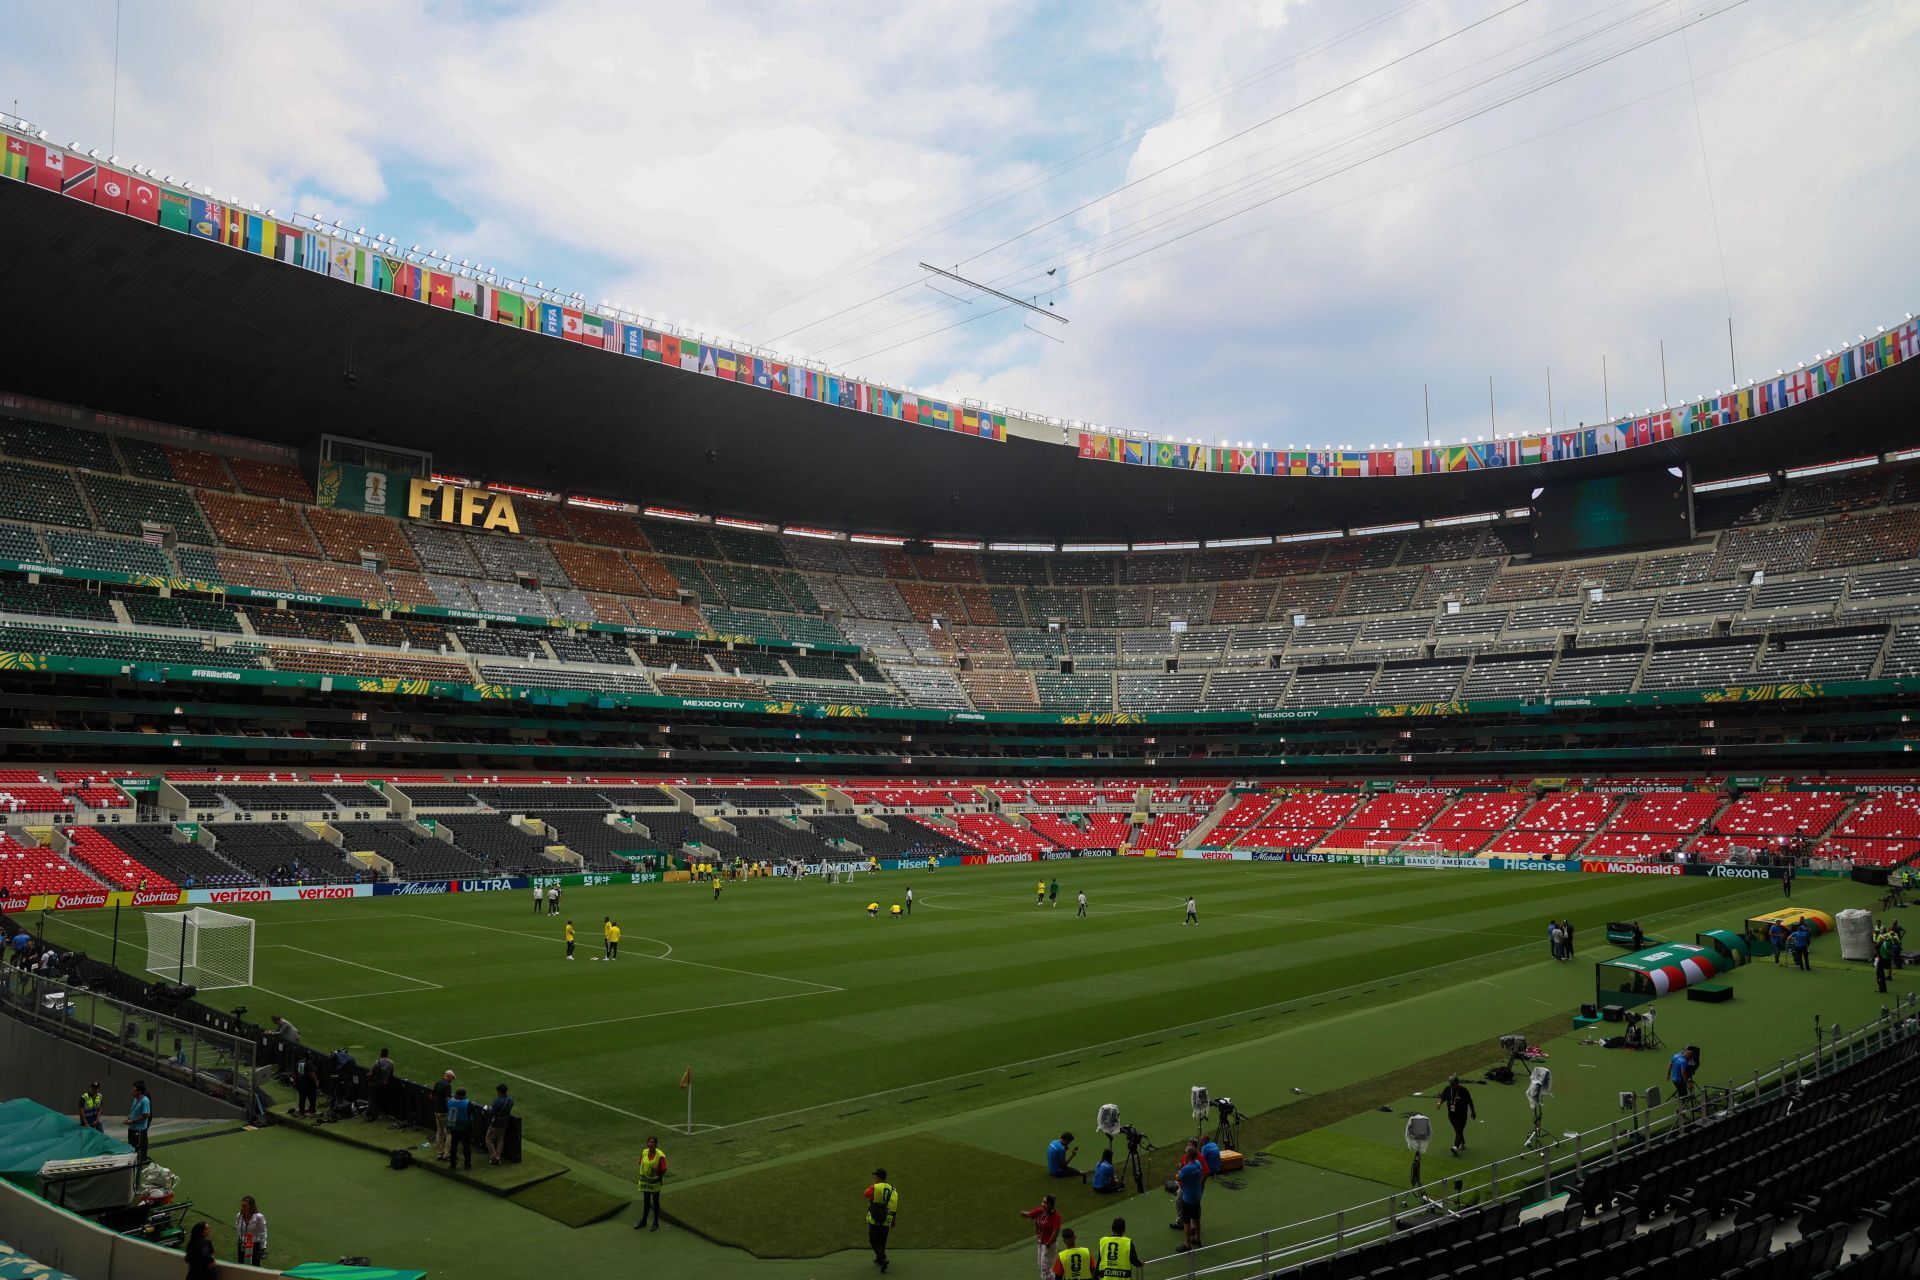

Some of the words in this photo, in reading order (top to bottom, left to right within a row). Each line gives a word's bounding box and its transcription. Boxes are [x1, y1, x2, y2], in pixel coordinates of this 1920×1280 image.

[548, 309, 557, 332] FIFA
[629, 331, 637, 352] FIFA
[408, 478, 520, 533] FIFA
[19, 564, 63, 575] #FIFAWorldCup
[251, 590, 295, 600] MEXICO
[624, 627, 656, 635] MEXICO
[192, 669, 240, 680] #FIFAWorldCup
[683, 700, 721, 708] MEXICO
[1855, 785, 1914, 793] MEXICO
[1047, 851, 1072, 860] Rexona
[1083, 848, 1112, 857] Rexona
[1125, 848, 1145, 856] Sabritas
[1156, 849, 1177, 857] Sabritas
[1201, 851, 1232, 860] verizon
[1253, 852, 1284, 861] Michelob
[1292, 854, 1324, 862] ULTRA
[898, 859, 940, 869] Hisene
[987, 853, 1032, 864] McDonald's
[1503, 858, 1566, 871] Hisense
[1607, 863, 1681, 875] McDonald's
[1717, 866, 1769, 879] Rexona
[298, 885, 354, 899] verizon
[392, 882, 447, 896] Michelob
[463, 880, 512, 892] ULTRA
[133, 891, 179, 905] Sabritas
[210, 888, 271, 903] verizon
[57, 894, 106, 909] Sabritas
[1104, 1269, 1127, 1277] CURITY
